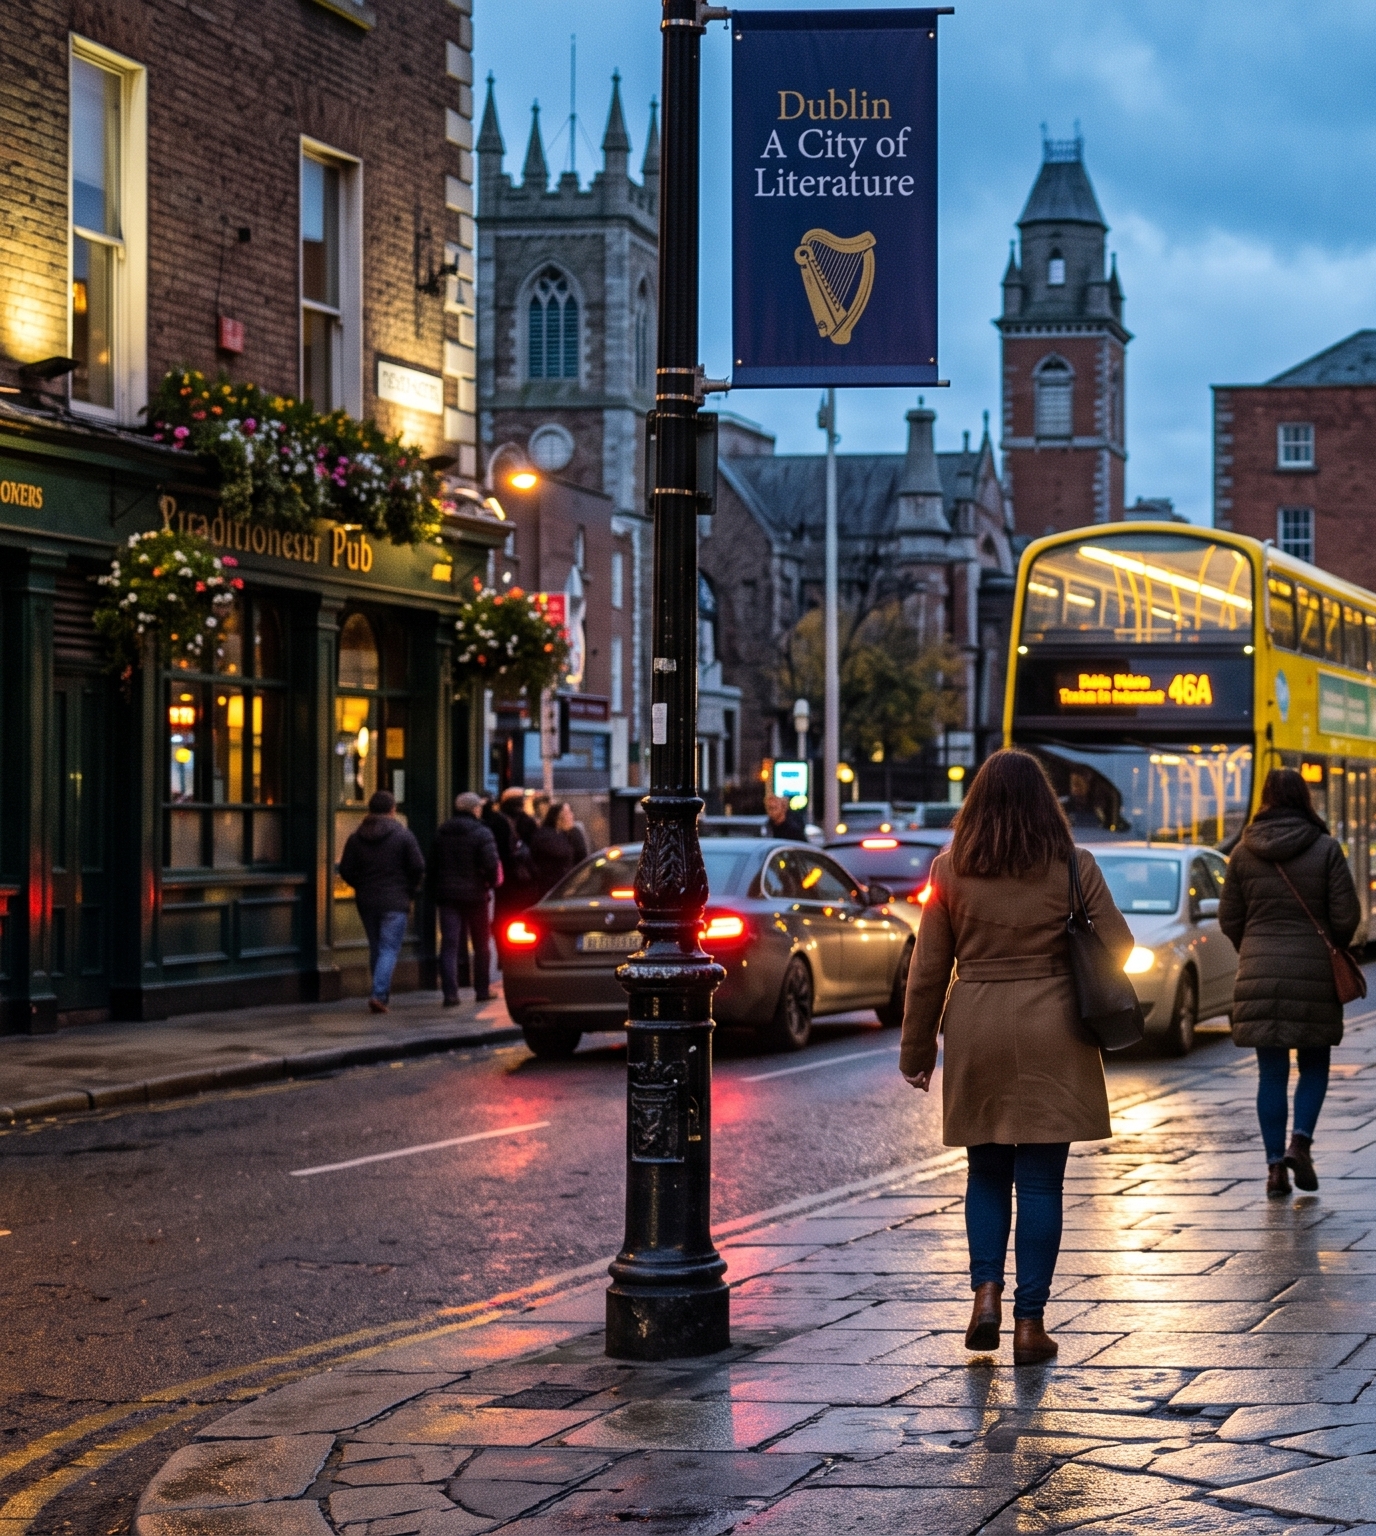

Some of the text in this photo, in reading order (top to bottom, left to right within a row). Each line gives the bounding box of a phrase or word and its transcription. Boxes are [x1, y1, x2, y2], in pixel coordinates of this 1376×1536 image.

[777, 89, 892, 120] Dublin
[760, 126, 912, 168] A City of
[754, 167, 915, 197] Literature
[332, 526, 373, 573] Pub
[1168, 673, 1213, 705] 46A
